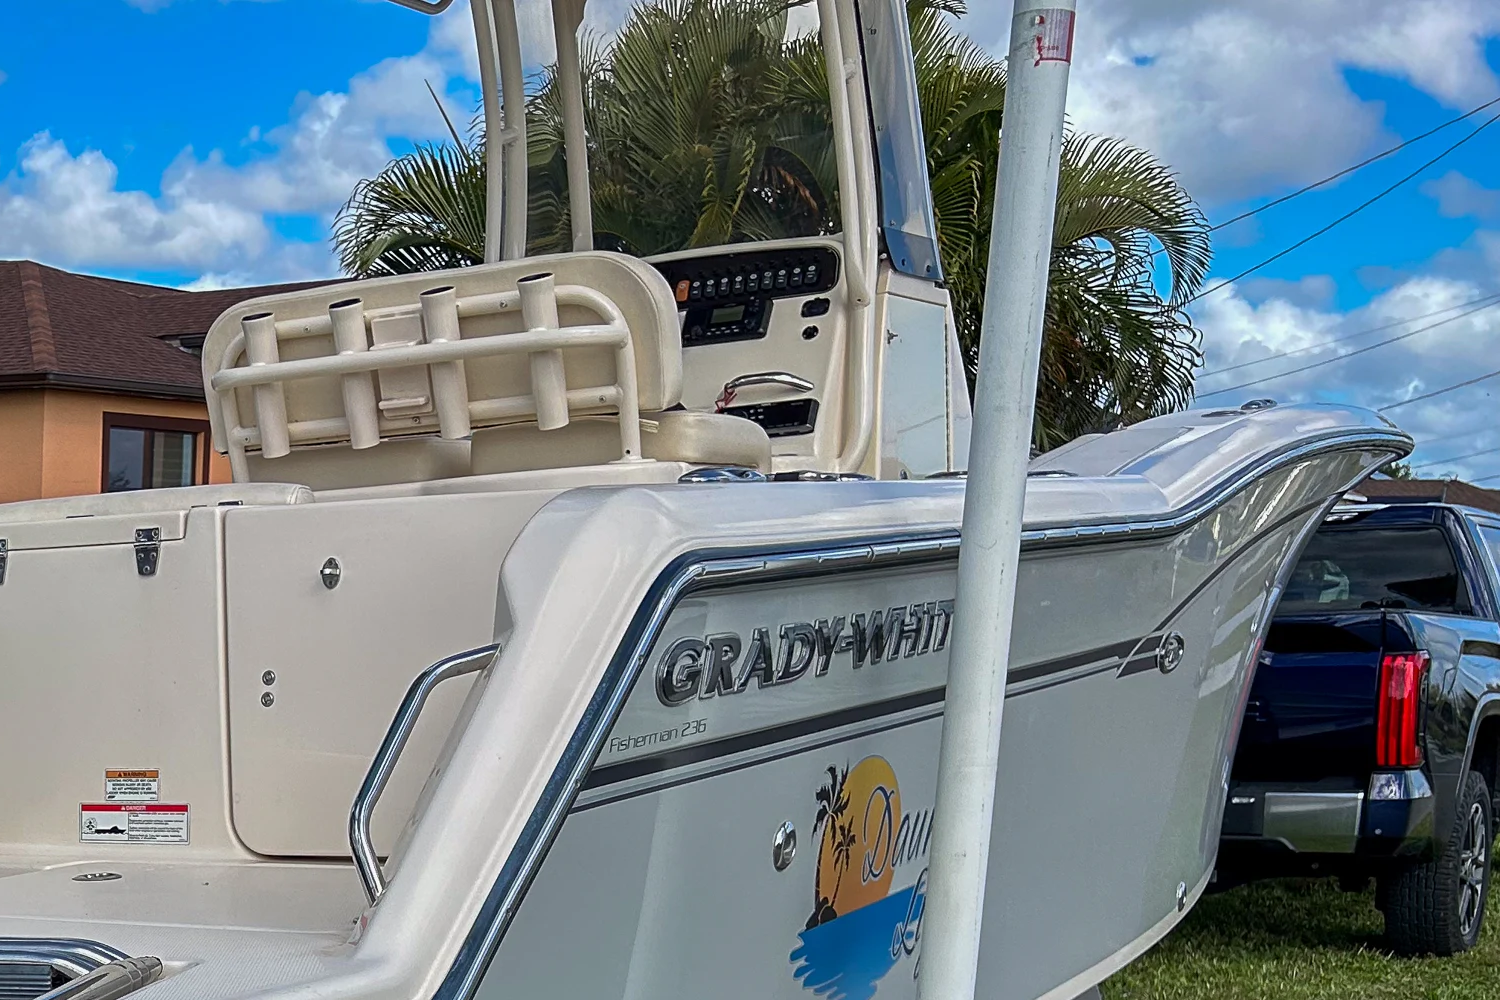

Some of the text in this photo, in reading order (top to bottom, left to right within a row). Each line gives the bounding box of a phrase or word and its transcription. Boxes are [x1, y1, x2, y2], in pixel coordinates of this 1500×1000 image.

[655, 598, 955, 708] GRADY-WHIT
[608, 718, 708, 754] Fisherman 236
